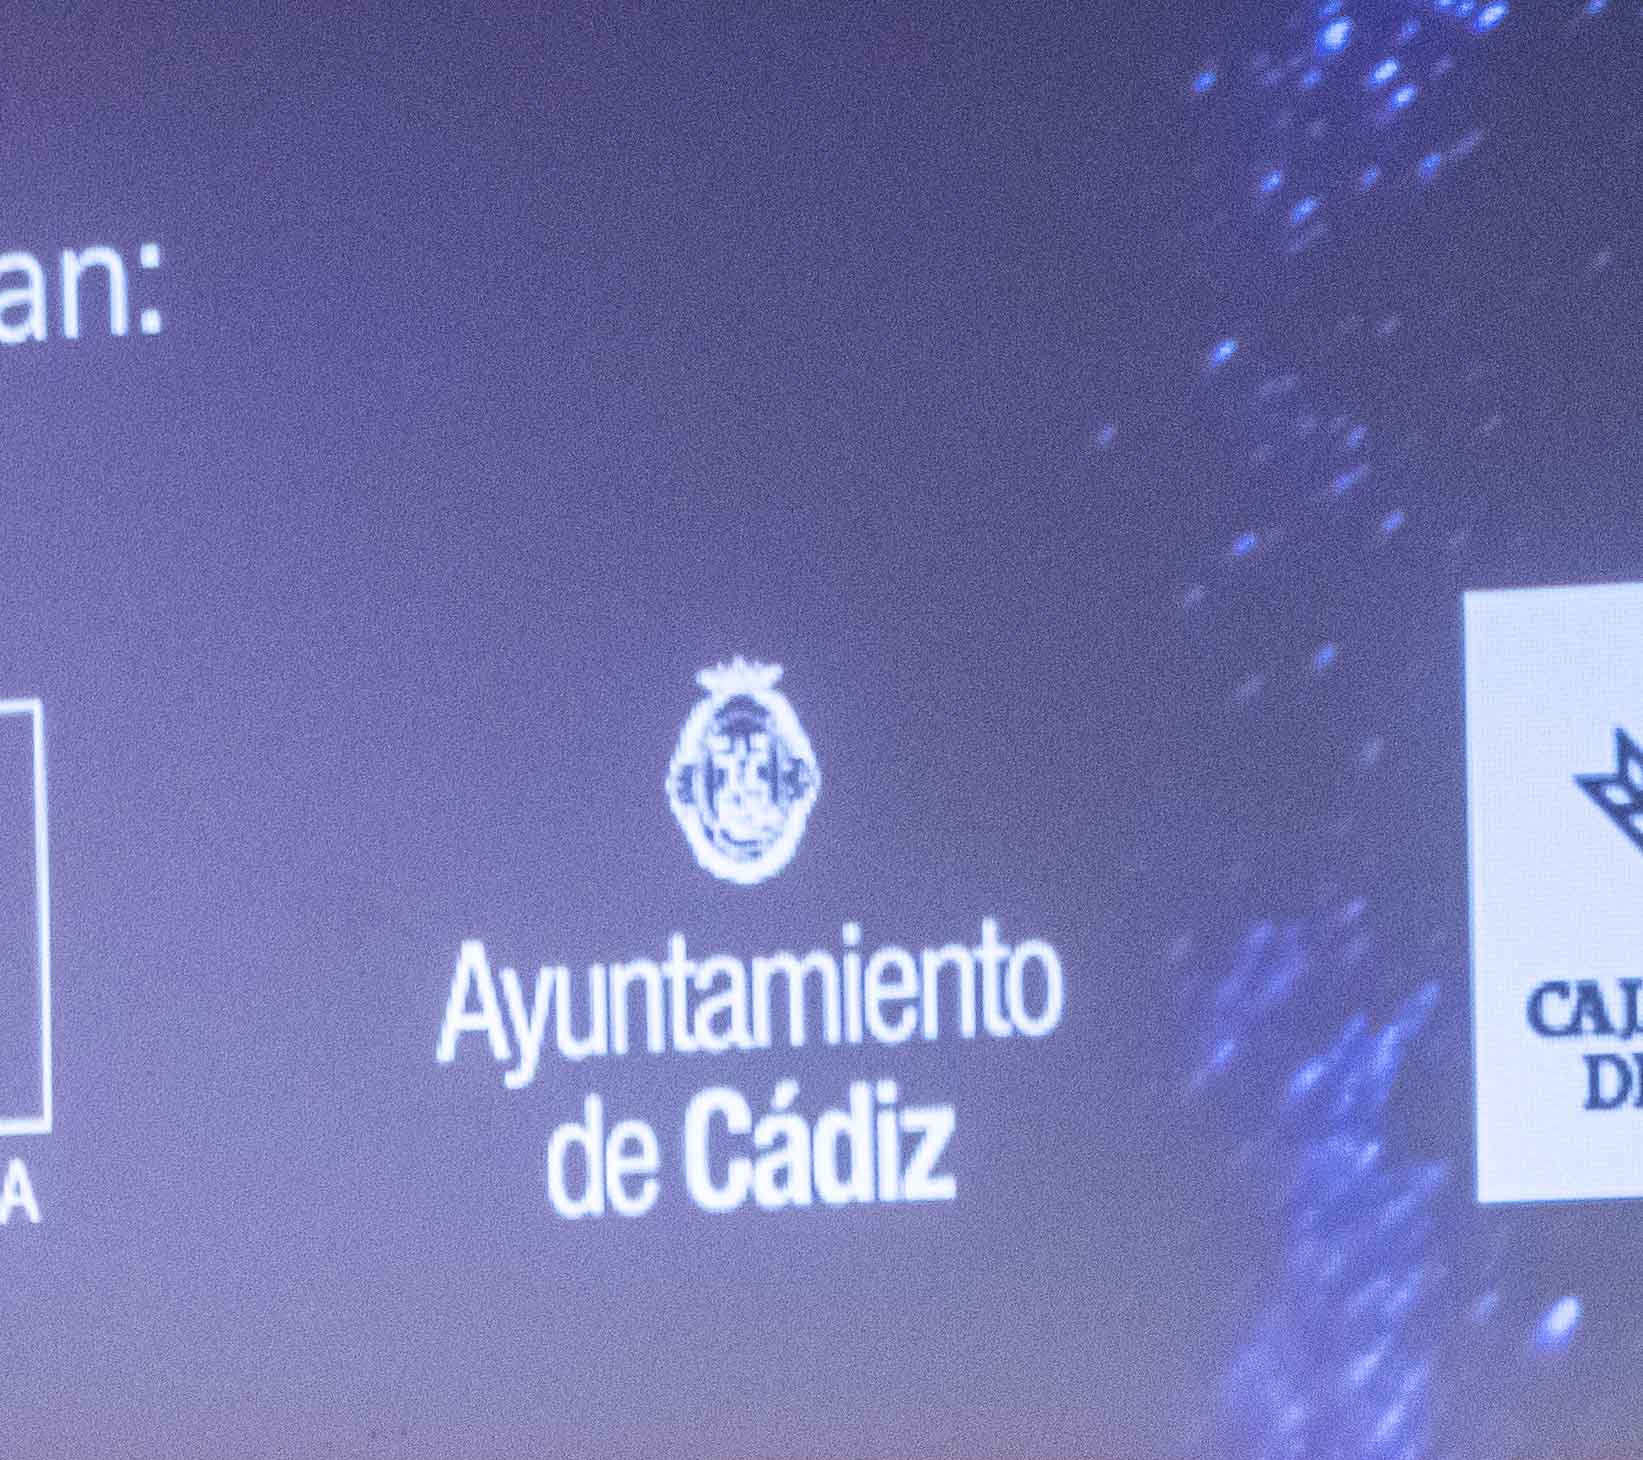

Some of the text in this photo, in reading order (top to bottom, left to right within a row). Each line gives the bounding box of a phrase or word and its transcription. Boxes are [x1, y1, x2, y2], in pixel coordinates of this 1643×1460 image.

[435, 917, 1065, 1089] Ayuntamiento
[1526, 977, 1643, 1042] CAJ
[1583, 1051, 1643, 1111] D
[546, 1078, 958, 1220] de Cádiz
